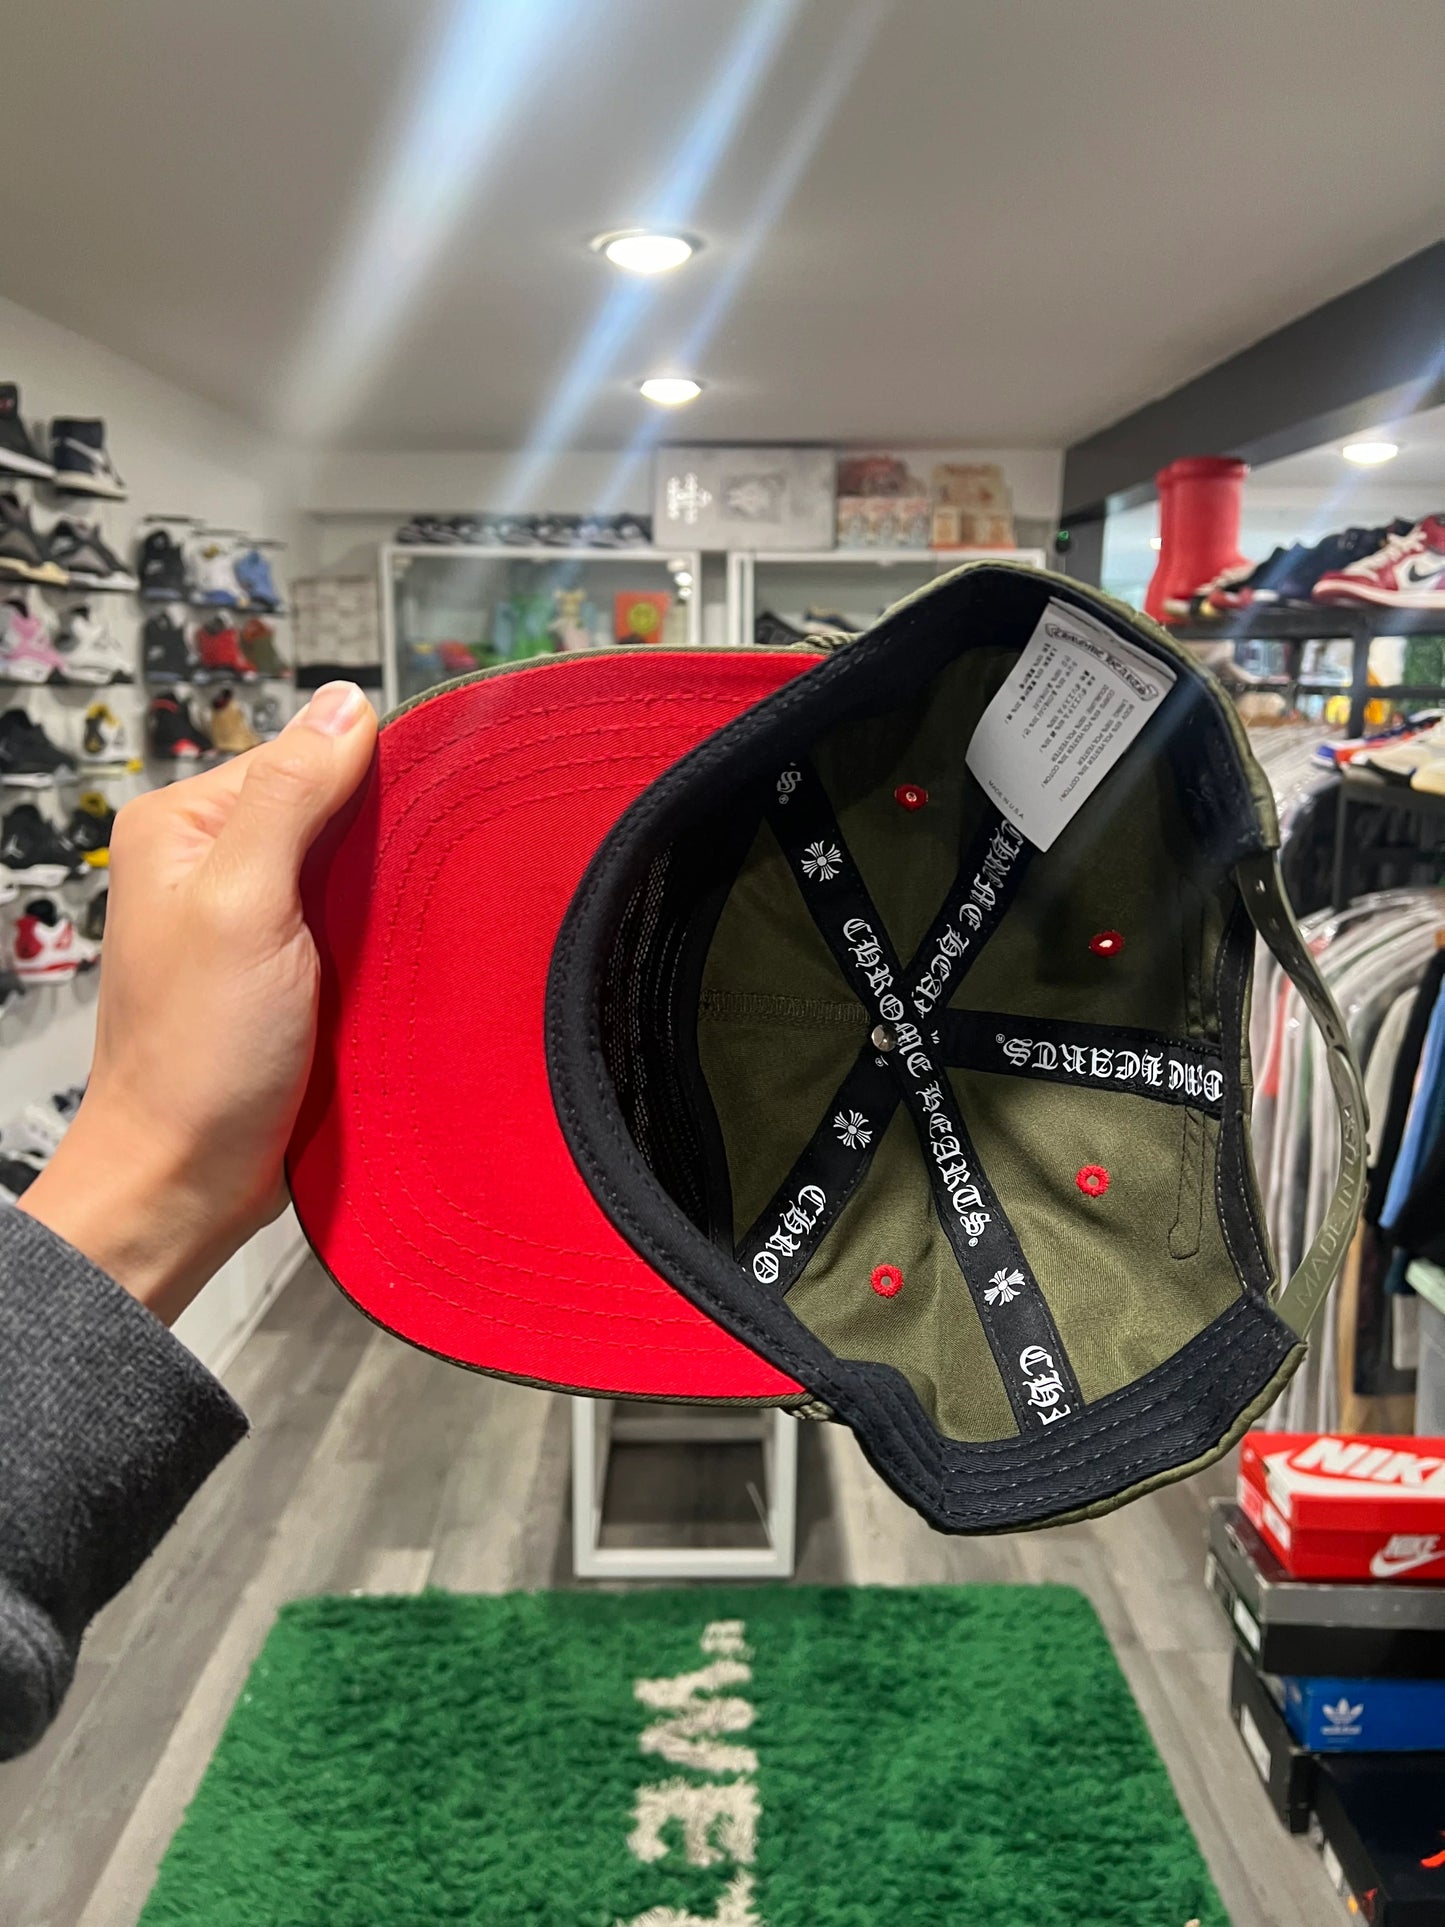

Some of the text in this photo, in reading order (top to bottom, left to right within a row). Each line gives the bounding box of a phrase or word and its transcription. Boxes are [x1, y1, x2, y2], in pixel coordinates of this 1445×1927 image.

[1050, 728, 1076, 762] POLYESTER
[1065, 720, 1092, 754] POLYESTER
[1076, 732, 1103, 766] POLYESTER
[1086, 732, 1113, 765] POLYESTER
[1060, 775, 1080, 799] COTTON
[843, 918, 933, 1078] CHROME
[1296, 1212, 1346, 1308] MADE
[1337, 1172, 1355, 1209] IN
[1384, 1534, 1440, 1558] NIKE
